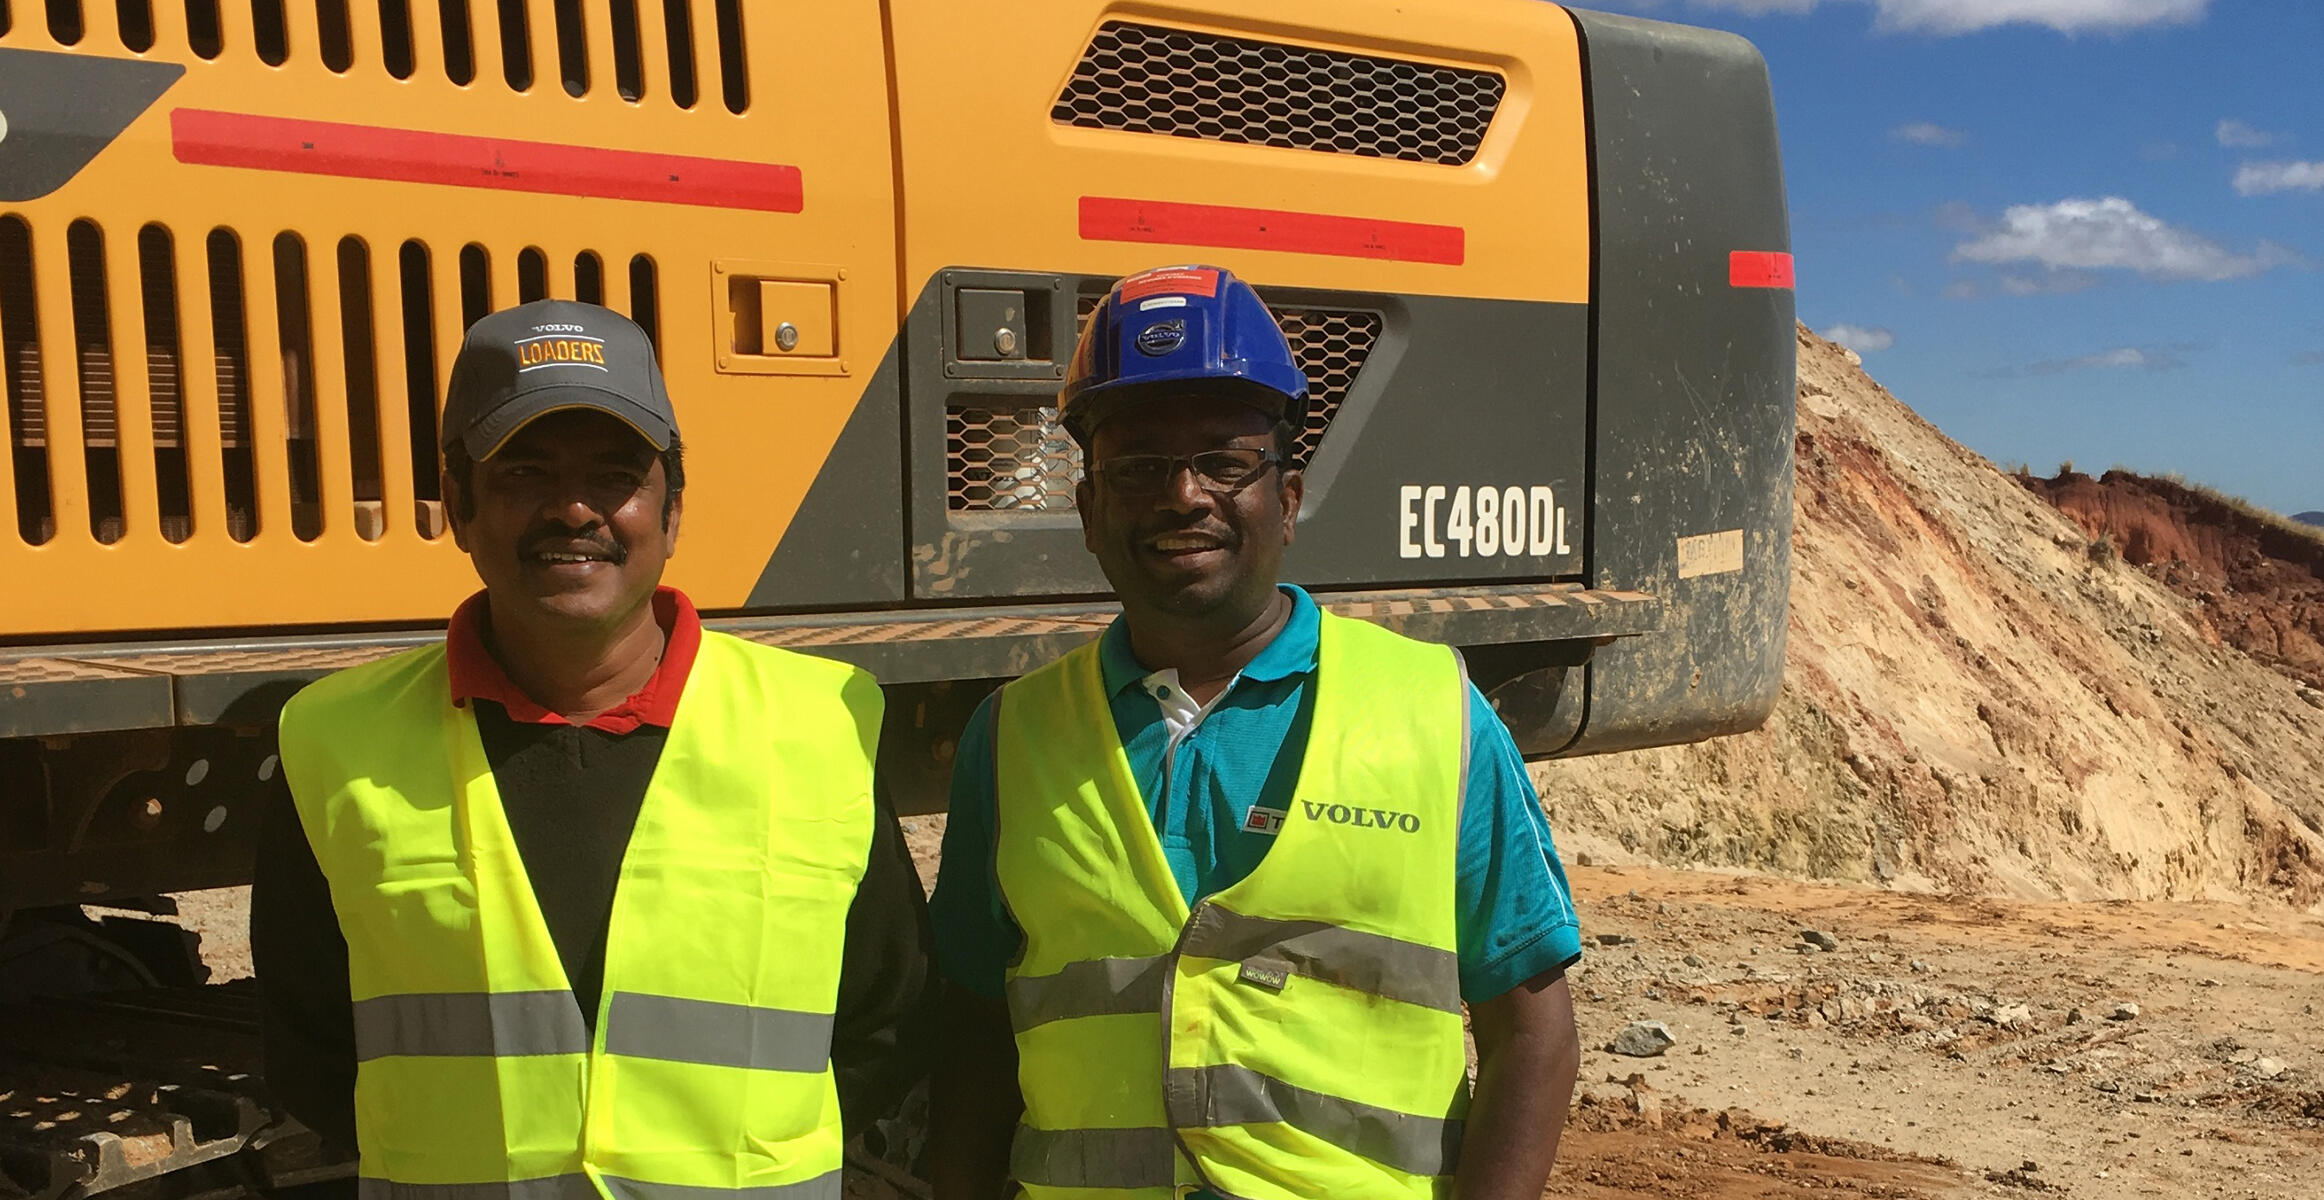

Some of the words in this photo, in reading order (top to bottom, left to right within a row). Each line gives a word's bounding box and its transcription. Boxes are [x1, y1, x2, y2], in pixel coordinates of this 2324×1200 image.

[532, 324, 584, 332] VOLVO
[1142, 331, 1181, 342] VOLVO
[518, 340, 605, 366] LOADERS
[1301, 799, 1420, 833] VOLVO
[1246, 969, 1281, 985] WOWOW
